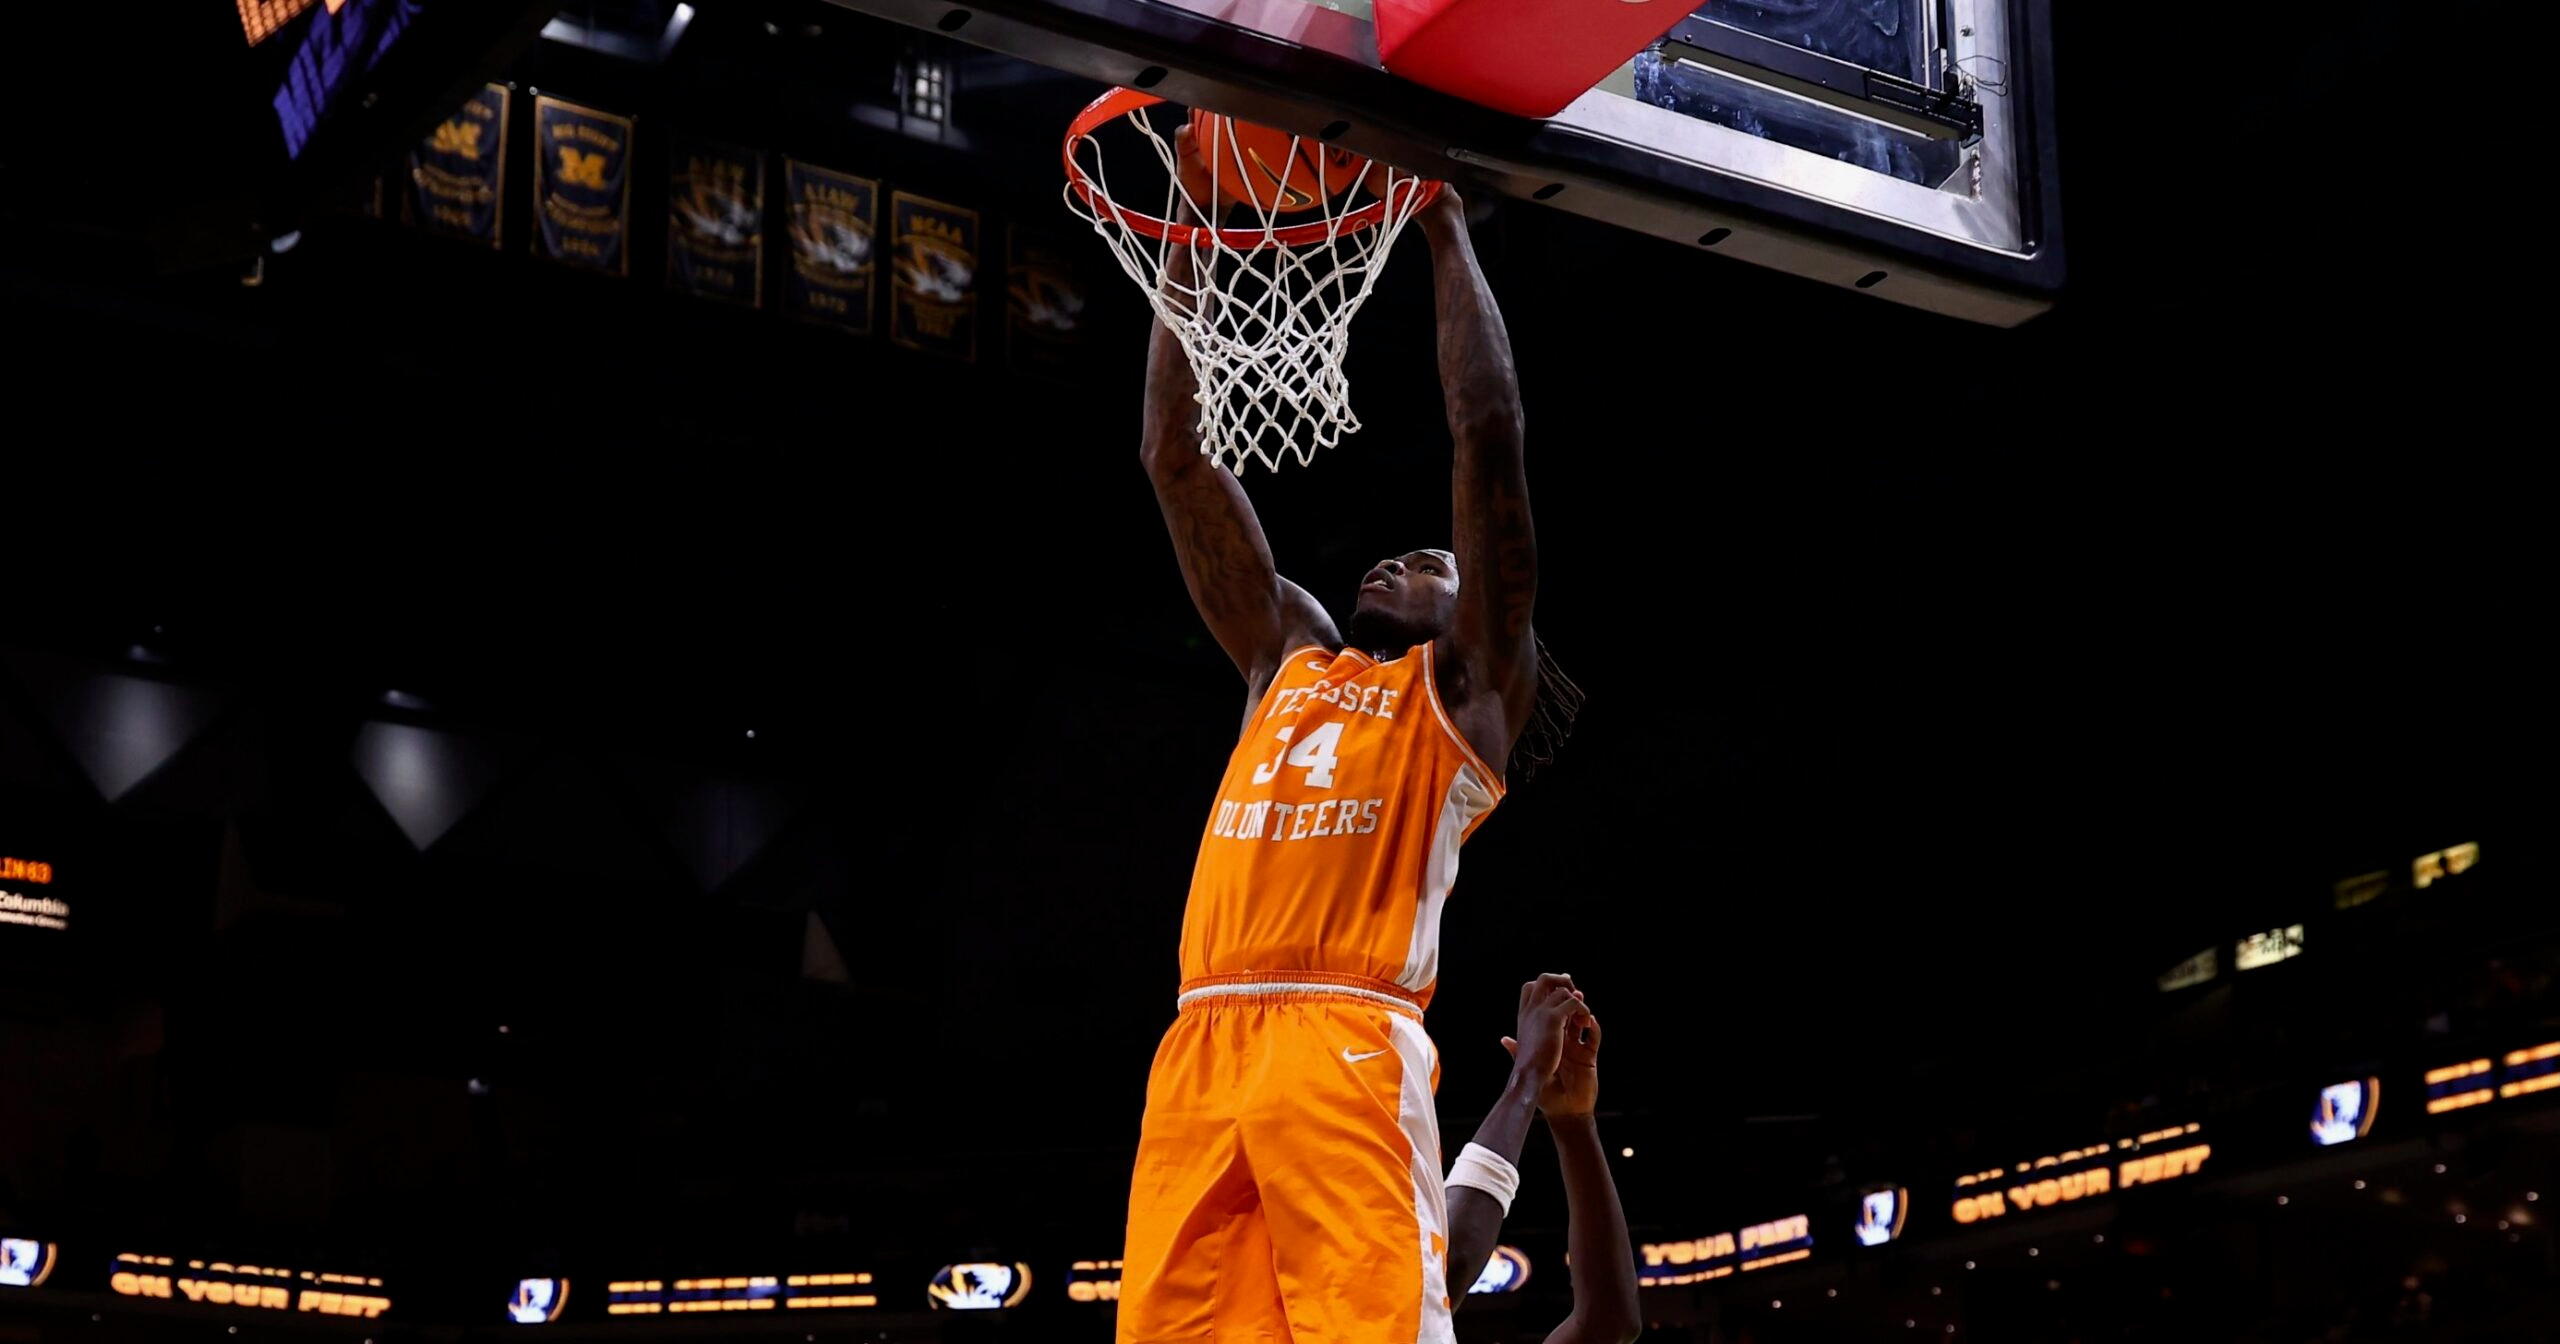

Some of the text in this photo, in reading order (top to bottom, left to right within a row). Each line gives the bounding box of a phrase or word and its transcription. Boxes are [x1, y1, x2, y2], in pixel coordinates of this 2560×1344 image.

[558, 145, 608, 191] M
[1252, 721, 1345, 789] 34
[1213, 798, 1383, 841] OLUNTEERS
[1953, 1191, 2006, 1224] ON
[2007, 1167, 2111, 1210] YOUR
[110, 1272, 173, 1298] ON
[177, 1278, 290, 1309] YOUR
